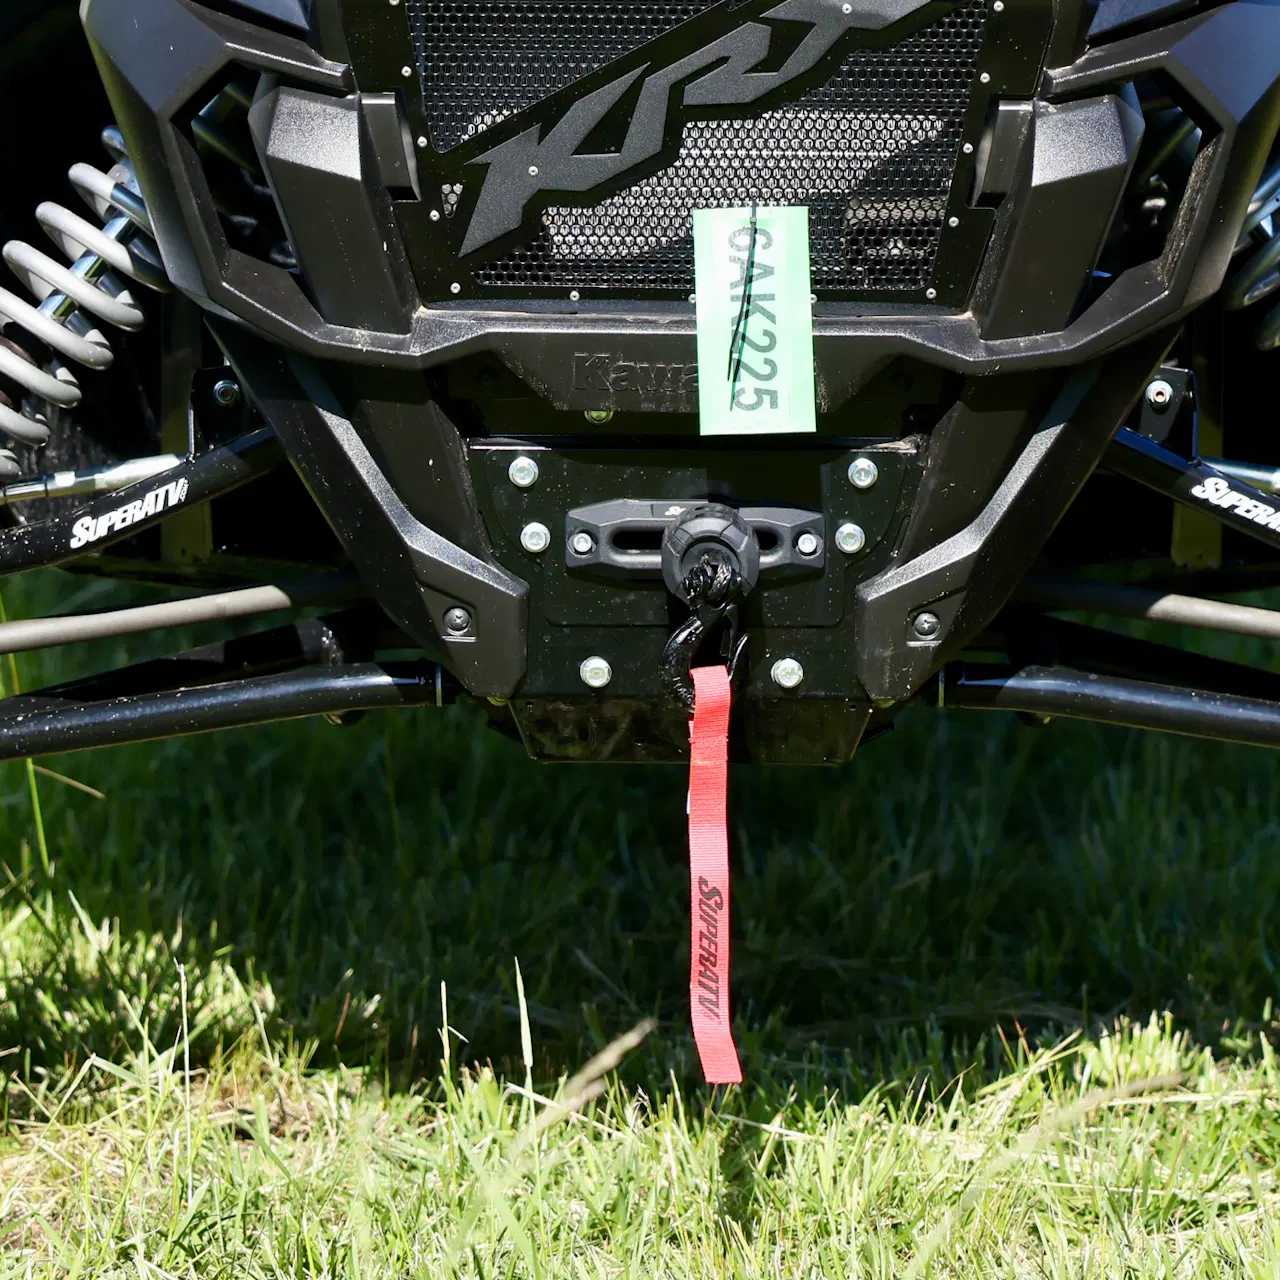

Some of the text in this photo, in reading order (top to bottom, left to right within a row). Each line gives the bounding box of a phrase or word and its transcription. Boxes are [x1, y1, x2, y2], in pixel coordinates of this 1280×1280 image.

[573, 352, 699, 392] Kawa
[70, 476, 186, 549] SUPERATV
[698, 875, 724, 1020] SUPERATV
